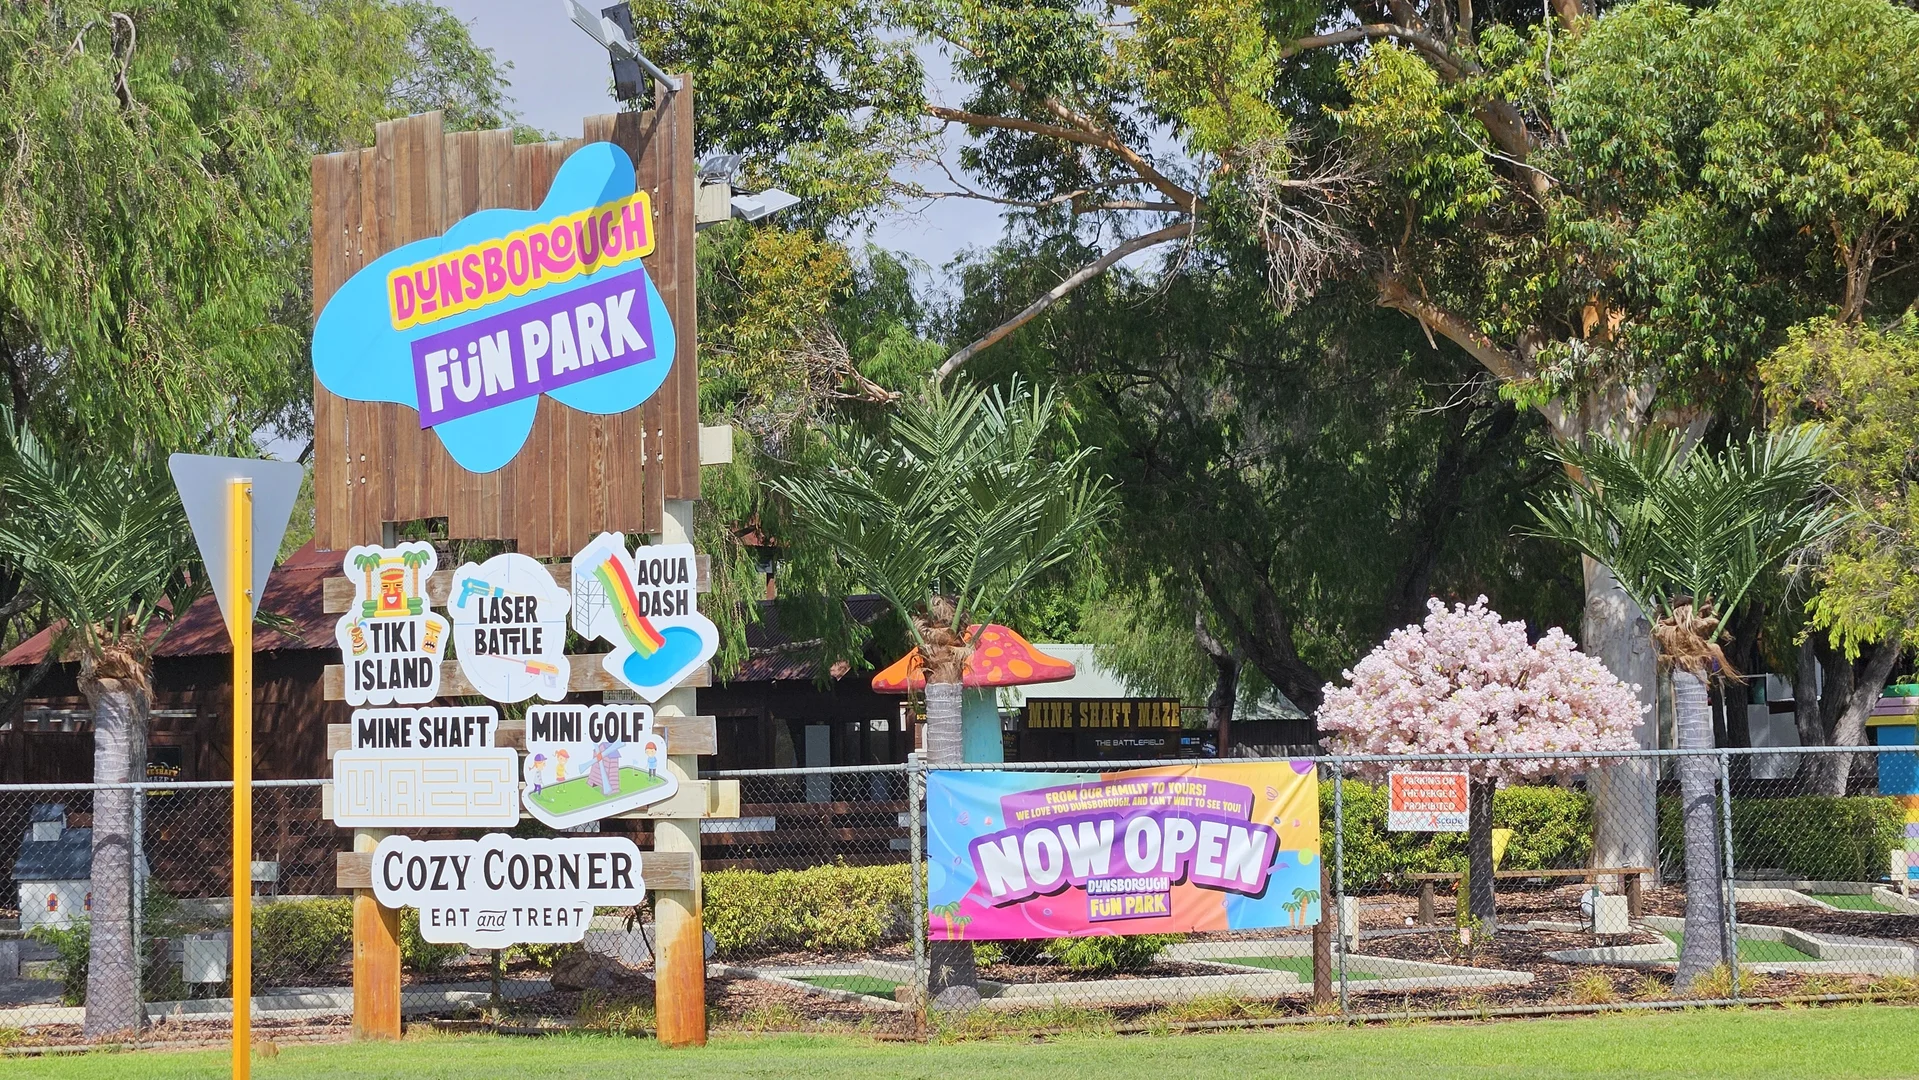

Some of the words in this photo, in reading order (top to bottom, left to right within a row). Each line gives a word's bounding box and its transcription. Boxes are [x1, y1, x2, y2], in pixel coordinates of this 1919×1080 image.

[394, 201, 647, 320] DUNSBOROUGH
[521, 289, 647, 383] PARK
[637, 558, 689, 585] AQUA
[478, 595, 537, 624] LASER
[638, 590, 689, 617] DASH
[370, 620, 416, 653] TIKI
[474, 627, 543, 655] BATTLE
[354, 658, 433, 691] ISLAND
[532, 712, 581, 742] MINI
[589, 711, 644, 742] GOLF
[1028, 703, 1072, 728] MINE
[1080, 702, 1131, 727] SHAFT
[1138, 702, 1180, 727] MAZE
[358, 717, 411, 748] MINE
[419, 716, 489, 747] SHAFT
[1045, 790, 1077, 804] FROM
[1080, 788, 1103, 800] OUR
[1152, 782, 1165, 794] TO
[1168, 783, 1207, 796] YOURS!
[1401, 789, 1417, 798] THE
[1420, 789, 1447, 798] VERGE
[1449, 789, 1457, 798] IS
[1403, 776, 1441, 785] PARKING
[1442, 776, 1456, 785] ON
[1016, 810, 1030, 820] WE
[1031, 806, 1051, 818] LOVE
[1052, 802, 1070, 814] YOU
[1132, 796, 1148, 806] AND
[1150, 796, 1173, 806] CAN'T
[1174, 796, 1194, 807] WAIT
[1195, 798, 1205, 807] TO
[1207, 799, 1221, 810] SEE
[1223, 801, 1242, 813] YOU!
[1403, 802, 1456, 810] PROHIBITED
[383, 851, 471, 891] COZY
[484, 849, 635, 890] CORNER
[977, 818, 1115, 898] NOW
[1124, 816, 1270, 886] OPEN
[1088, 877, 1168, 893] DUNSBOROUGH
[1125, 894, 1168, 914] PARK
[431, 908, 470, 926] EAT
[477, 910, 507, 929] and
[515, 908, 584, 926] TREAT
